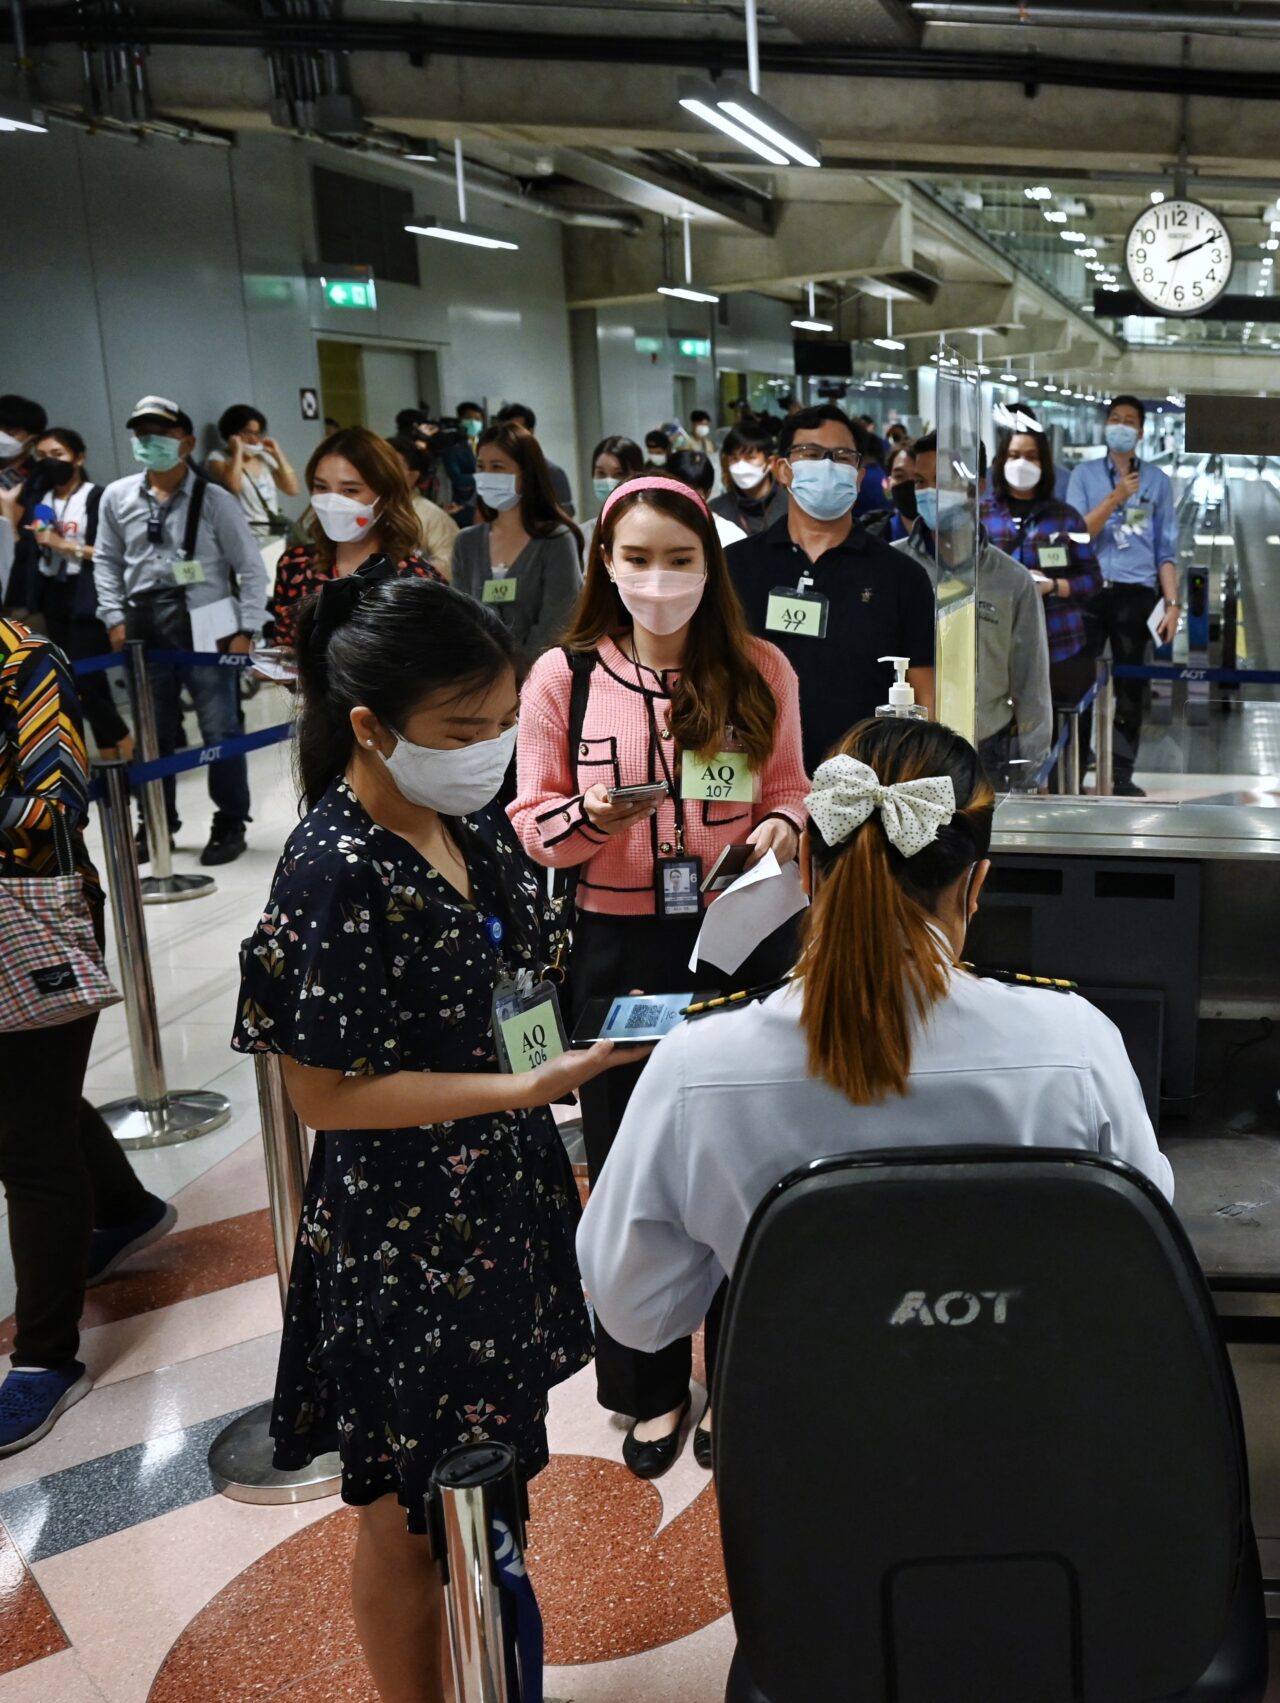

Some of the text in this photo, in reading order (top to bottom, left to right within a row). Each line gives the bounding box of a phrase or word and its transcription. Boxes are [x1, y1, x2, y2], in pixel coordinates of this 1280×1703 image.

[1156, 215, 1168, 230] 11
[1172, 210, 1188, 226] 12
[1140, 229, 1156, 244] 10
[1136, 248, 1147, 264] 9
[1211, 248, 1222, 264] 3
[1143, 267, 1154, 283] 8
[1205, 268, 1216, 282] 4
[1158, 281, 1168, 296] 7
[1174, 285, 1185, 301] 6
[1192, 281, 1203, 296] 5
[781, 608, 807, 624] AQ
[783, 619, 802, 631] 77
[218, 655, 247, 665] AOT
[1180, 669, 1206, 679] AOT
[199, 746, 222, 763] AOT
[701, 765, 735, 785] AQ
[706, 785, 732, 798] 107
[523, 1024, 547, 1053] AQ
[528, 1049, 547, 1069] 106
[889, 1290, 1016, 1326] AOT
